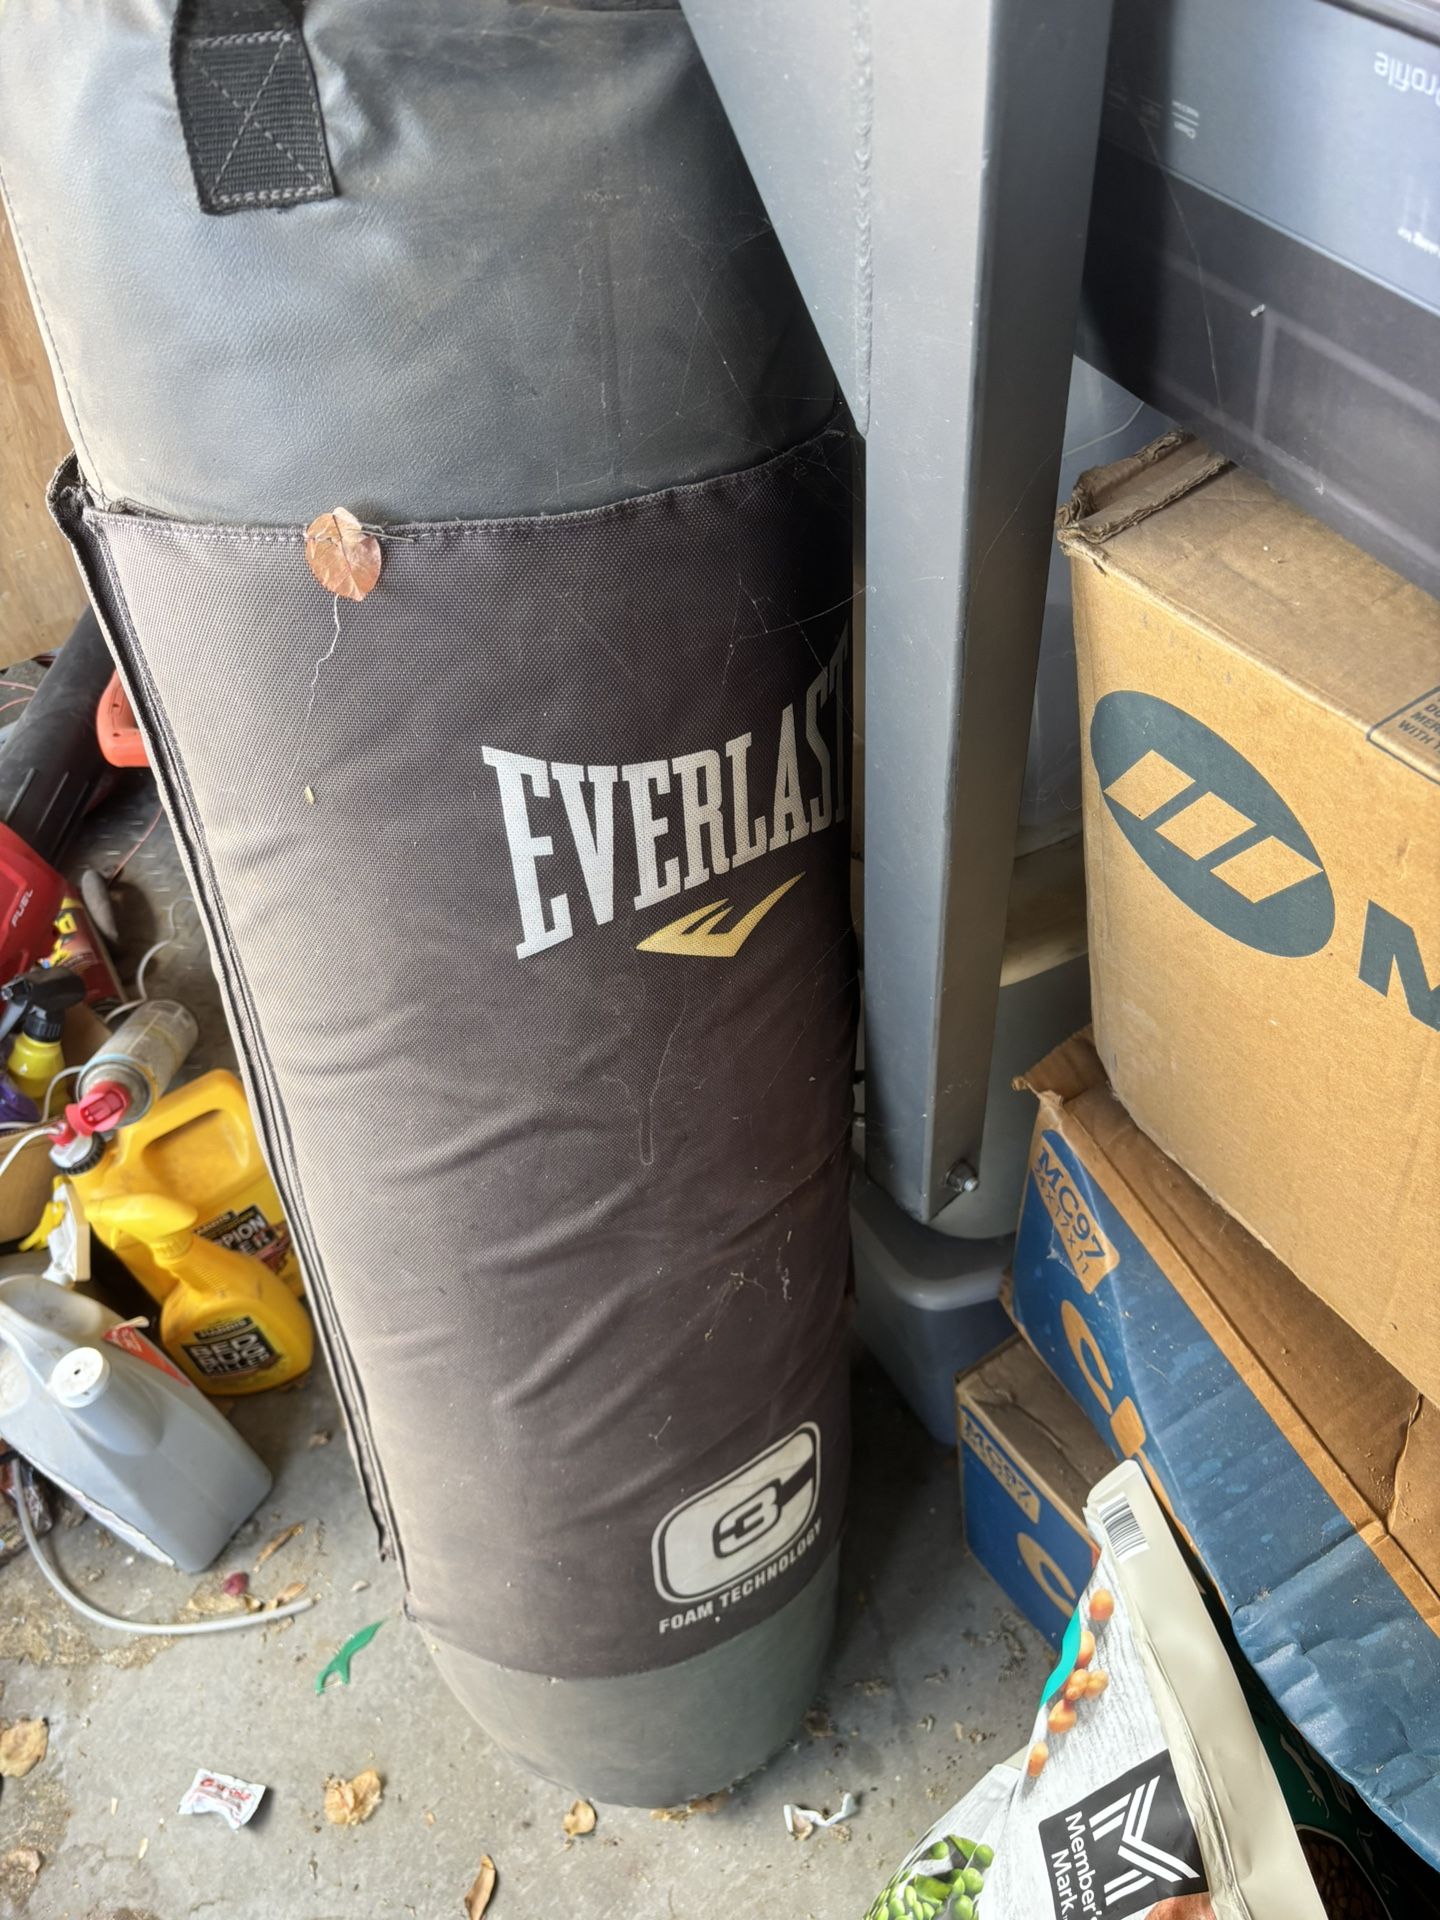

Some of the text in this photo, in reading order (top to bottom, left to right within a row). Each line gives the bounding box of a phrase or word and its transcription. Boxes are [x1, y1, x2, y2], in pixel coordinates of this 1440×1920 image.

[1398, 720, 1435, 745] WITH
[482, 619, 849, 960] EVERLAST
[215, 1214, 267, 1248] PION
[1040, 1147, 1105, 1258] MC97
[659, 1517, 822, 1634] FOAM TECHNOLOGY
